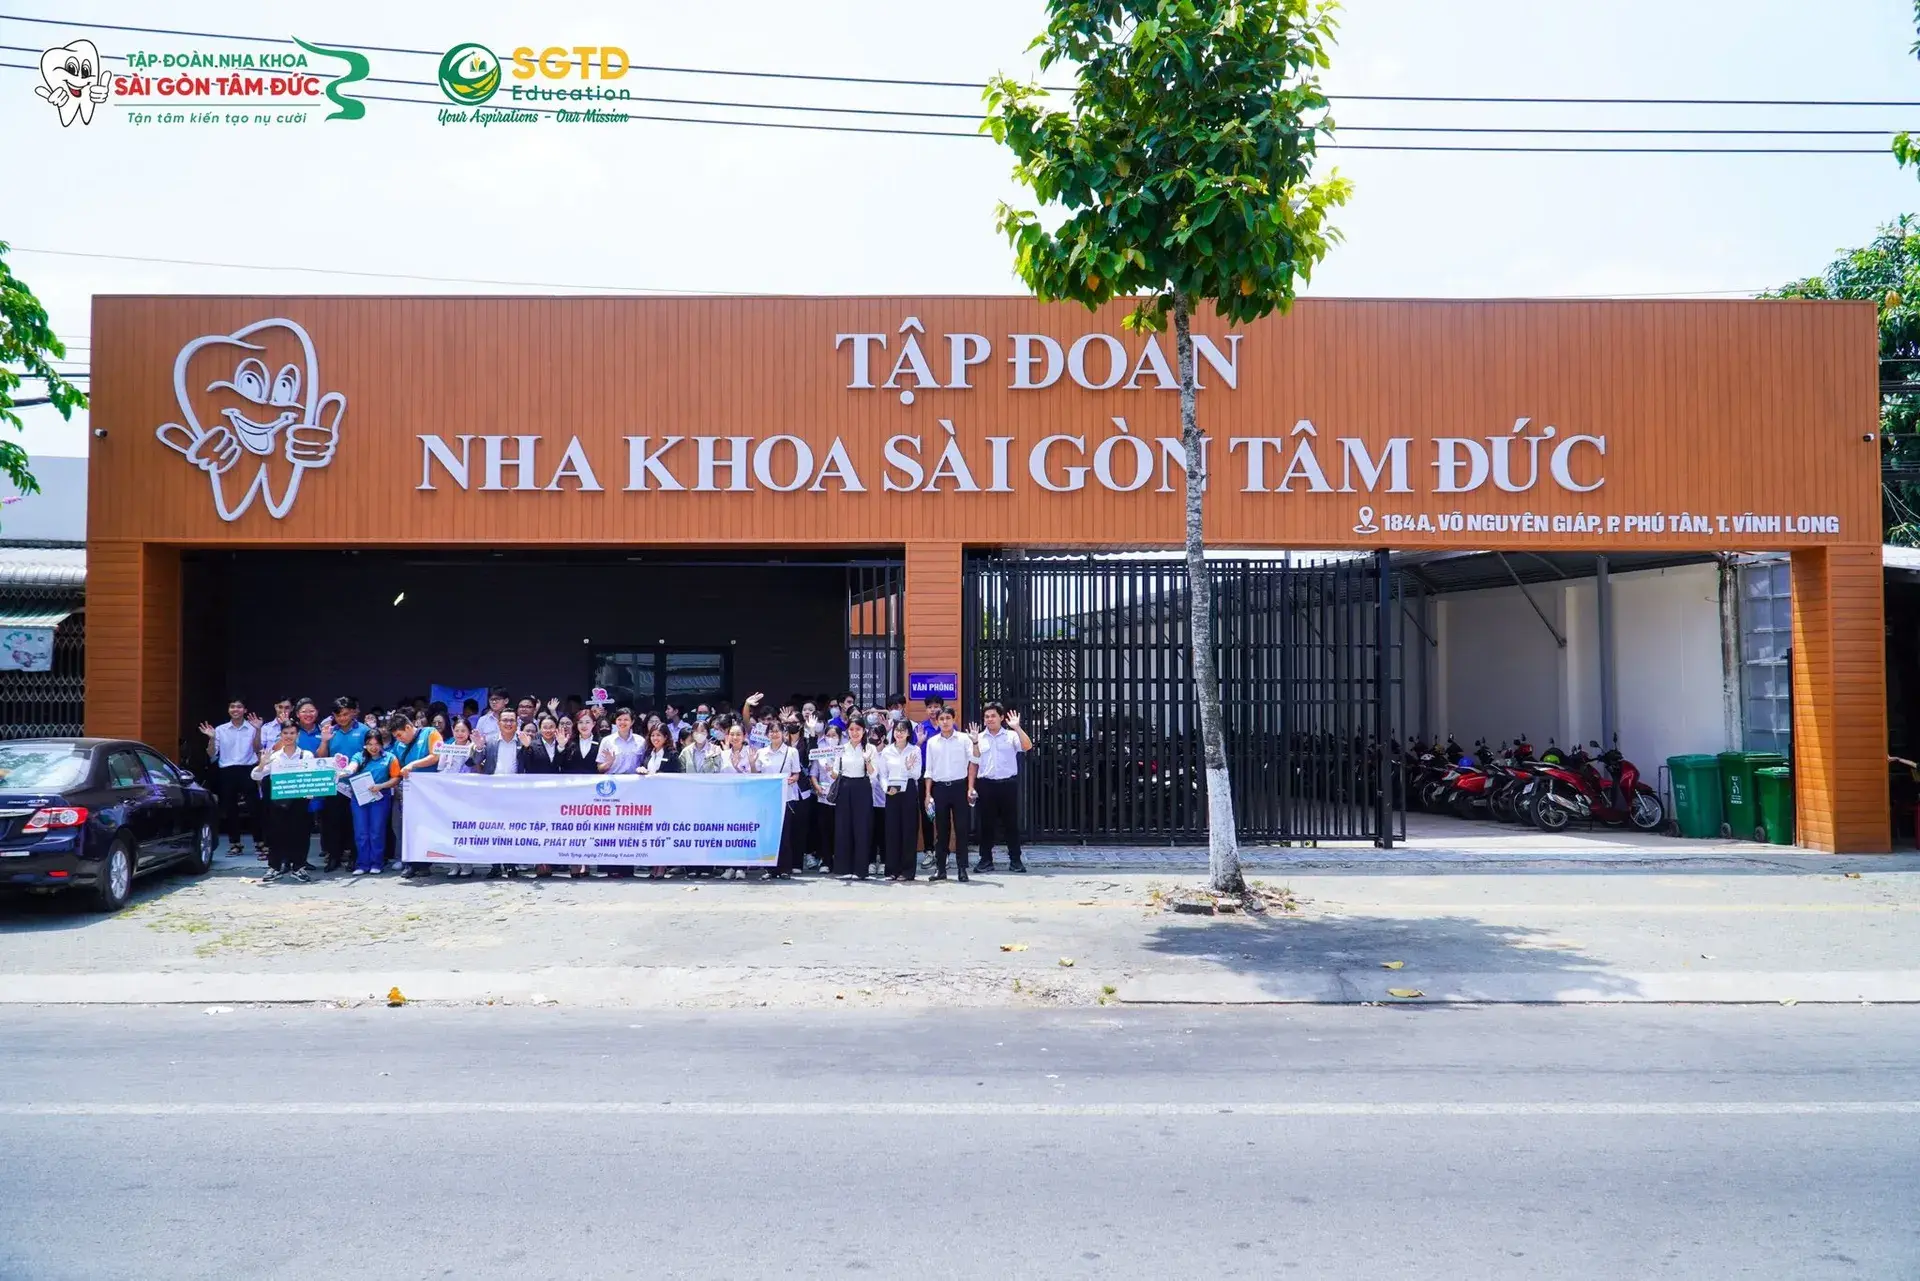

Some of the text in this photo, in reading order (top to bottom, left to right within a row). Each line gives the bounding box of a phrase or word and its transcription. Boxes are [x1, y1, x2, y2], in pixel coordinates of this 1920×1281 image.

[835, 316, 992, 406] TẬP
[415, 416, 1606, 494] NHA KHOA SÀI GÒN TÂM ĐỨC
[1381, 513, 1436, 534] 184A,
[1437, 511, 1466, 532] VÕ
[1467, 511, 1549, 533] NGUYÊN
[1552, 511, 1604, 535] GIÁP,
[1624, 511, 1665, 534] PHÚ
[1669, 511, 1714, 536] TÂN,
[1732, 511, 1781, 534] VĨNH
[1785, 515, 1840, 535] LONG
[911, 681, 955, 692] VĂN PHÒNG
[560, 803, 652, 816] CHƯƠNG TRÌNH
[452, 821, 476, 830] THAM
[508, 822, 527, 832] HỌC
[551, 822, 574, 831] TRAO
[593, 822, 615, 831] KINH
[617, 822, 653, 834] NGHIỆM
[656, 821, 671, 832] VỚI
[672, 821, 691, 832] CÁC
[693, 823, 724, 832] DOANH
[726, 822, 761, 834] NGHIỆP
[453, 836, 467, 847] TẠI
[491, 835, 513, 846] VĨNH
[514, 837, 542, 847] LONG,
[543, 836, 566, 847] PHÁT
[568, 838, 588, 847] HUY
[618, 837, 640, 848] VIÊN
[641, 838, 648, 848] 5
[673, 838, 692, 848] SAU
[693, 837, 723, 848] TUYÊN
[725, 837, 757, 848] DƯƠNG
